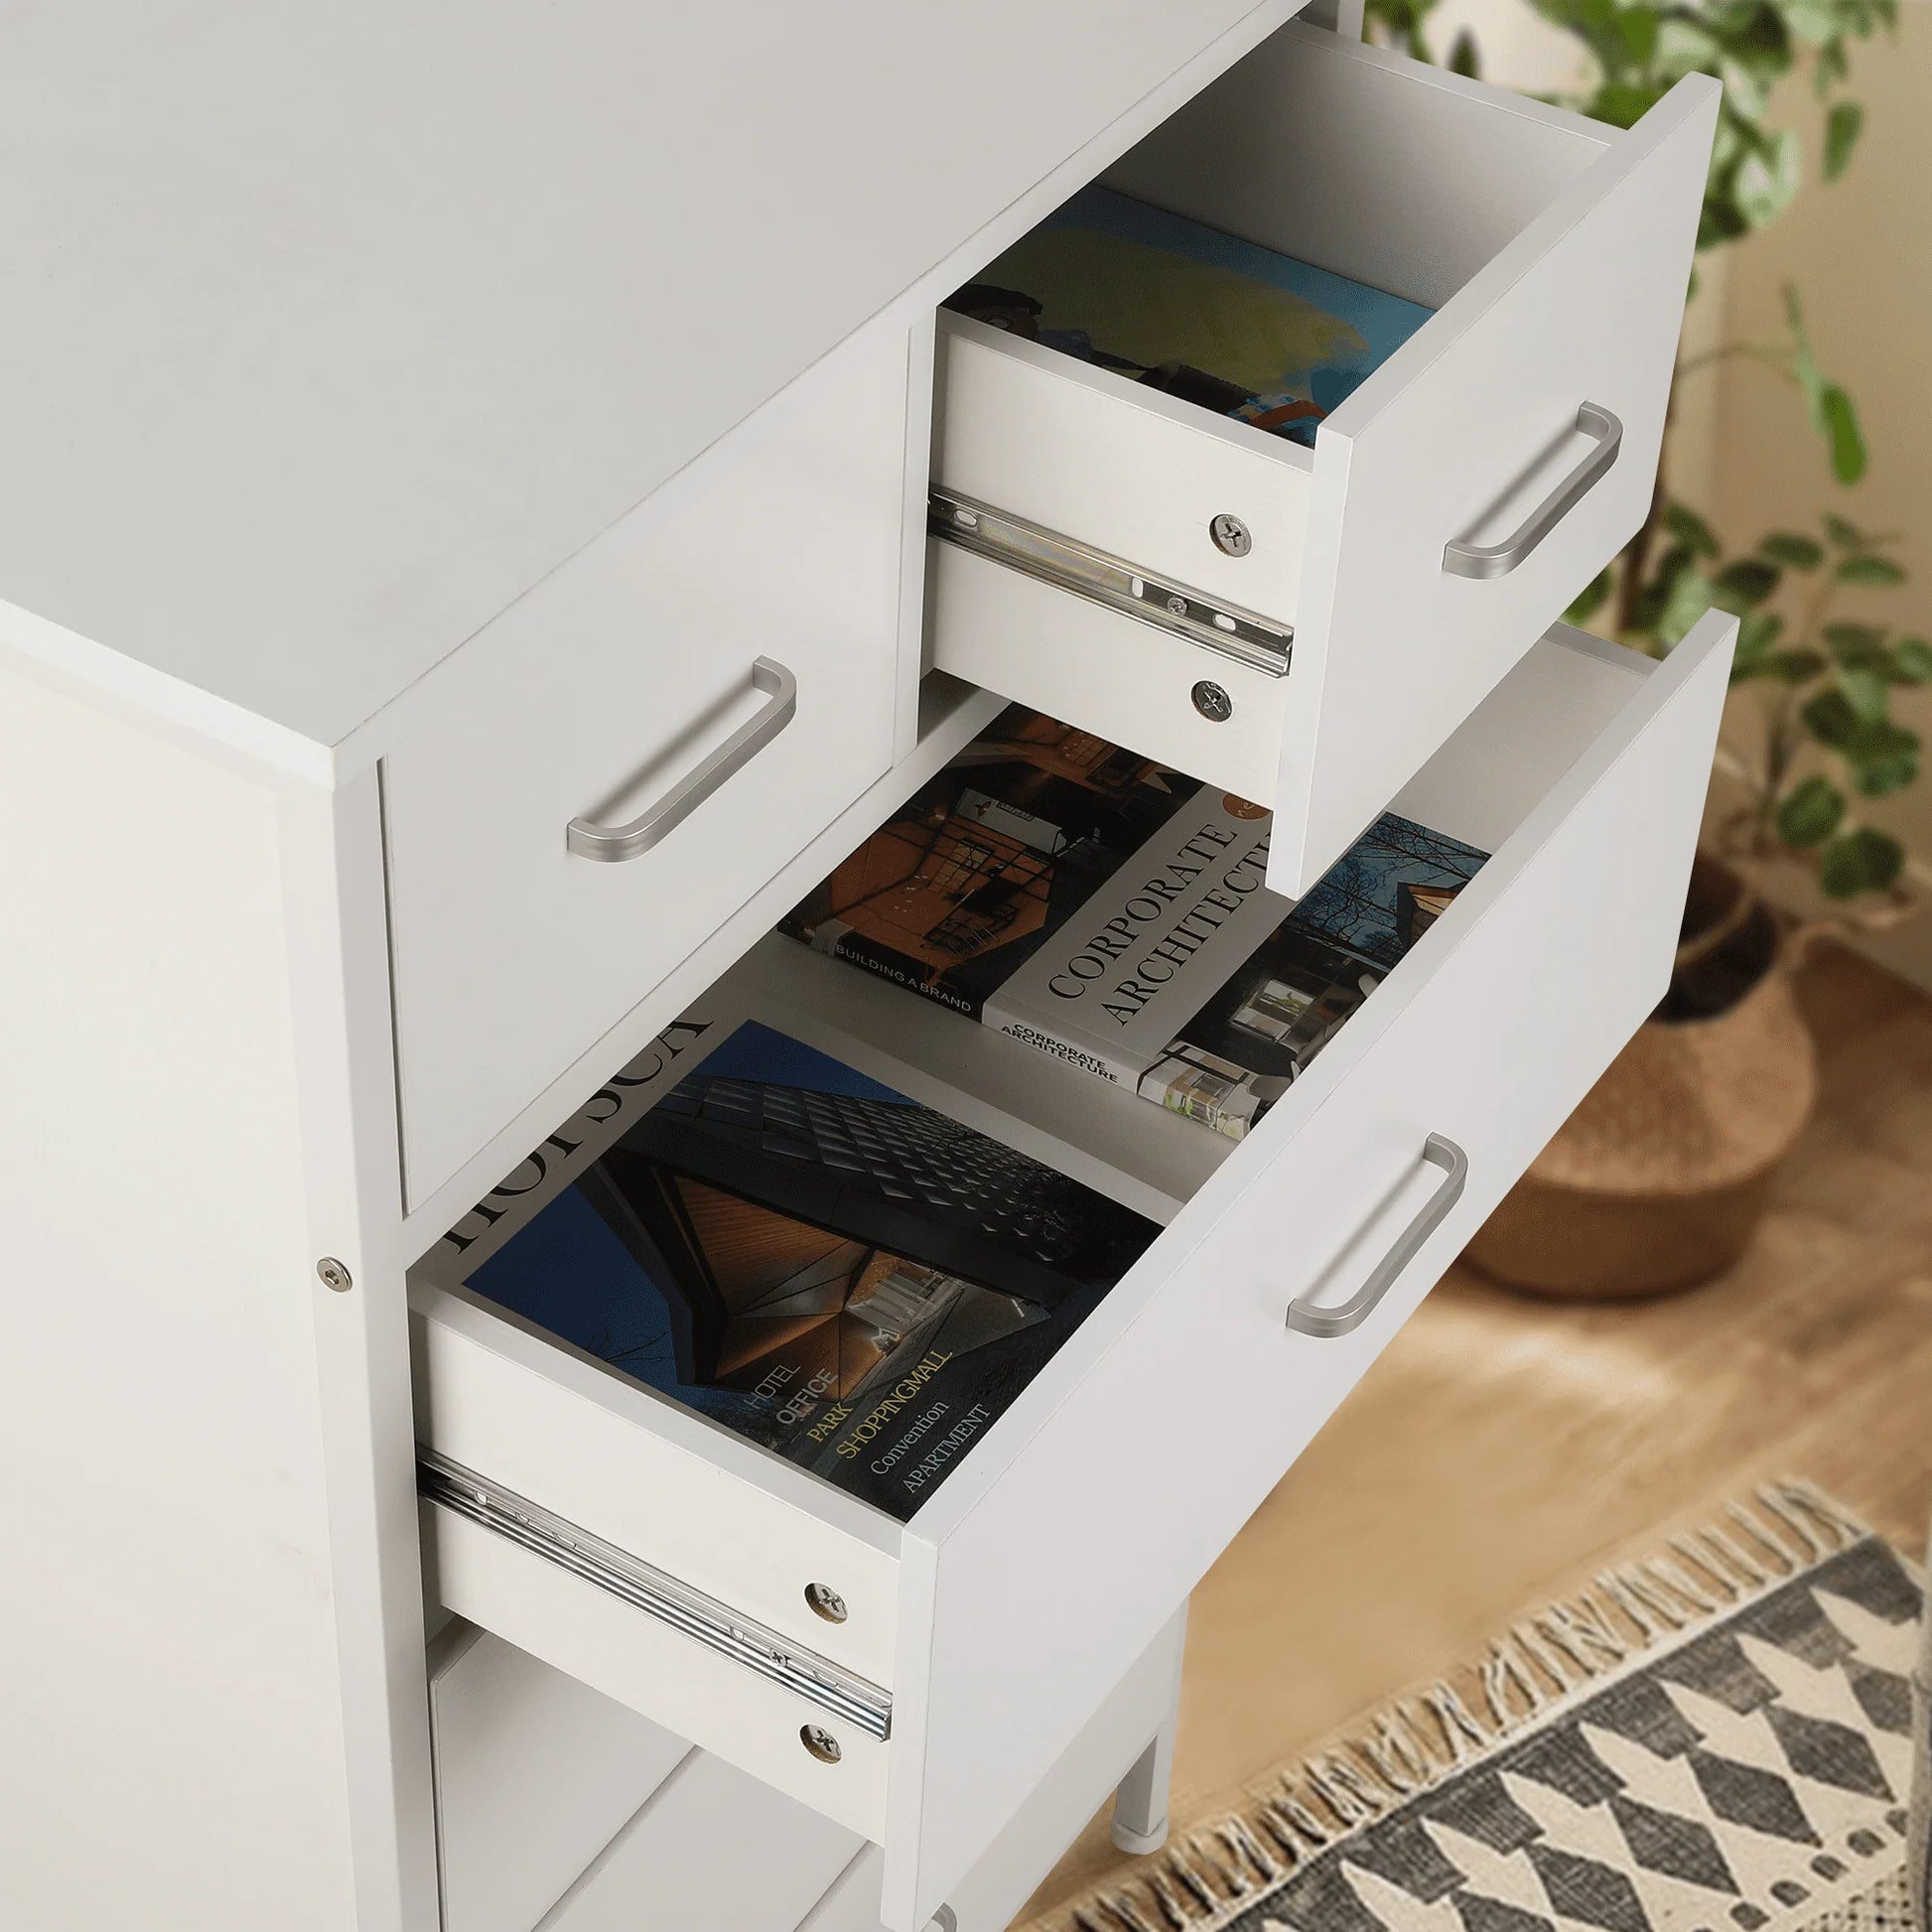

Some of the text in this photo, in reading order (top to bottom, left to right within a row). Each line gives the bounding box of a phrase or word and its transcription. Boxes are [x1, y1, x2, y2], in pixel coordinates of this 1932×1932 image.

[1048, 823, 1238, 1000] CORPORATE
[836, 944, 972, 1013] BUILDING A BRAND
[1001, 1026, 1118, 1083] ARCHITECTURE
[1014, 1024, 1106, 1070] CORPORATE
[745, 1364, 801, 1411] HOTEL
[775, 1368, 839, 1425] OFFICE
[836, 1349, 953, 1459] SHOPPINGMALL
[806, 1401, 854, 1443] PARK
[870, 1401, 950, 1475] Convention
[901, 1403, 991, 1493] APARTMENT
